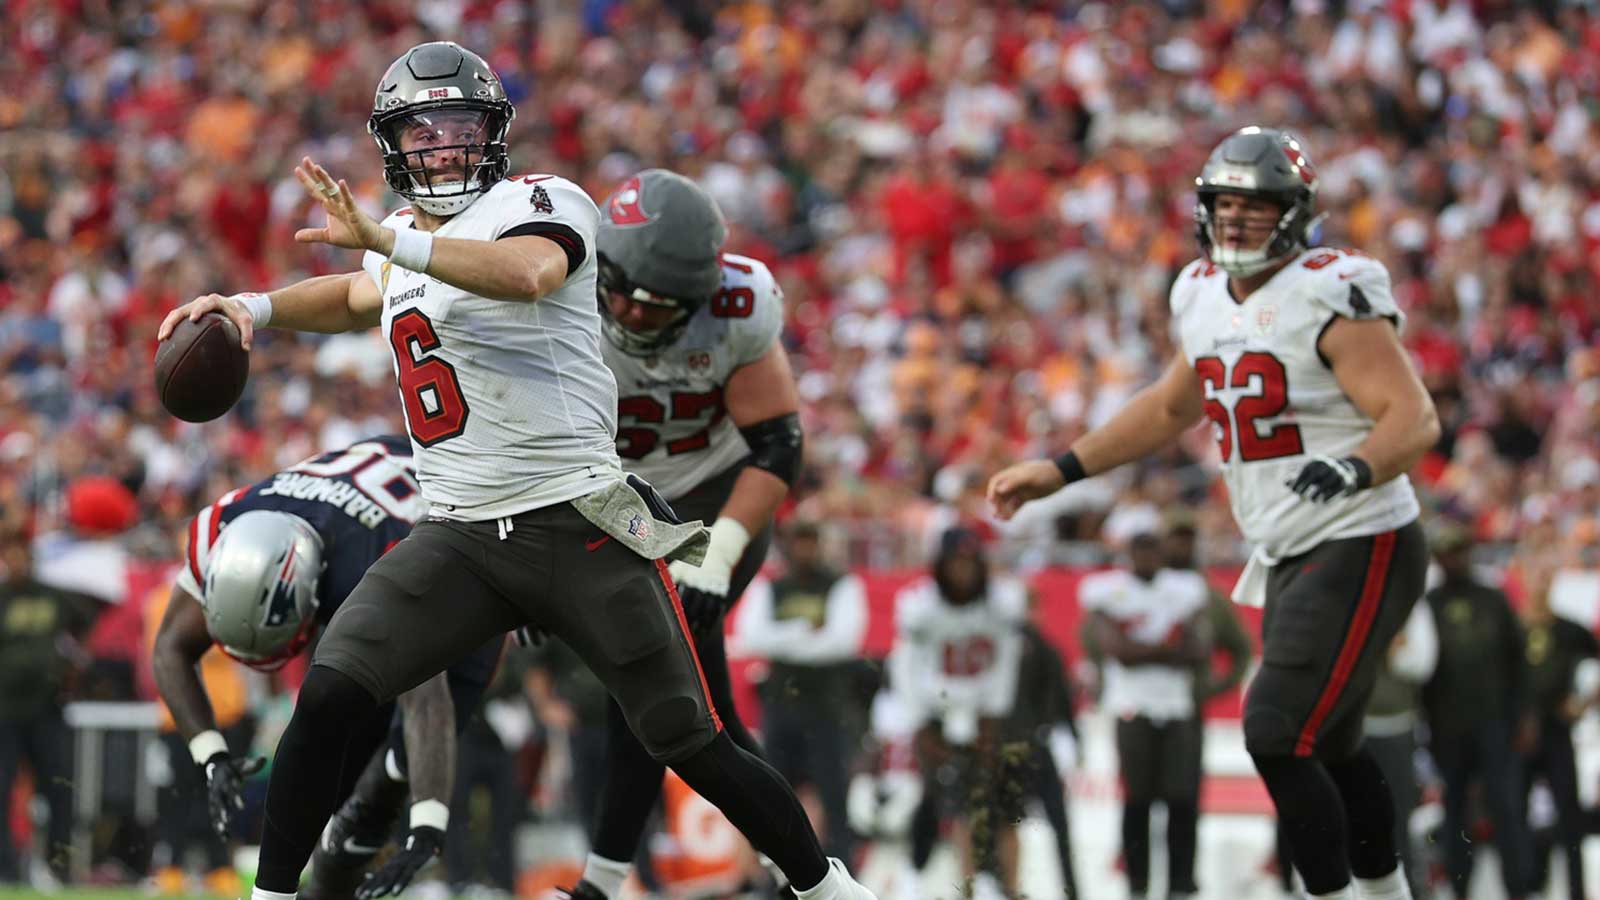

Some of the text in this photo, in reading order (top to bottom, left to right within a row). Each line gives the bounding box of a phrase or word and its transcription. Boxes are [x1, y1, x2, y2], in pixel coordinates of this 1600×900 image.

[389, 306, 470, 449] 6
[615, 385, 725, 461] 67
[1194, 351, 1305, 463] 62
[258, 471, 389, 530] BARMORE
